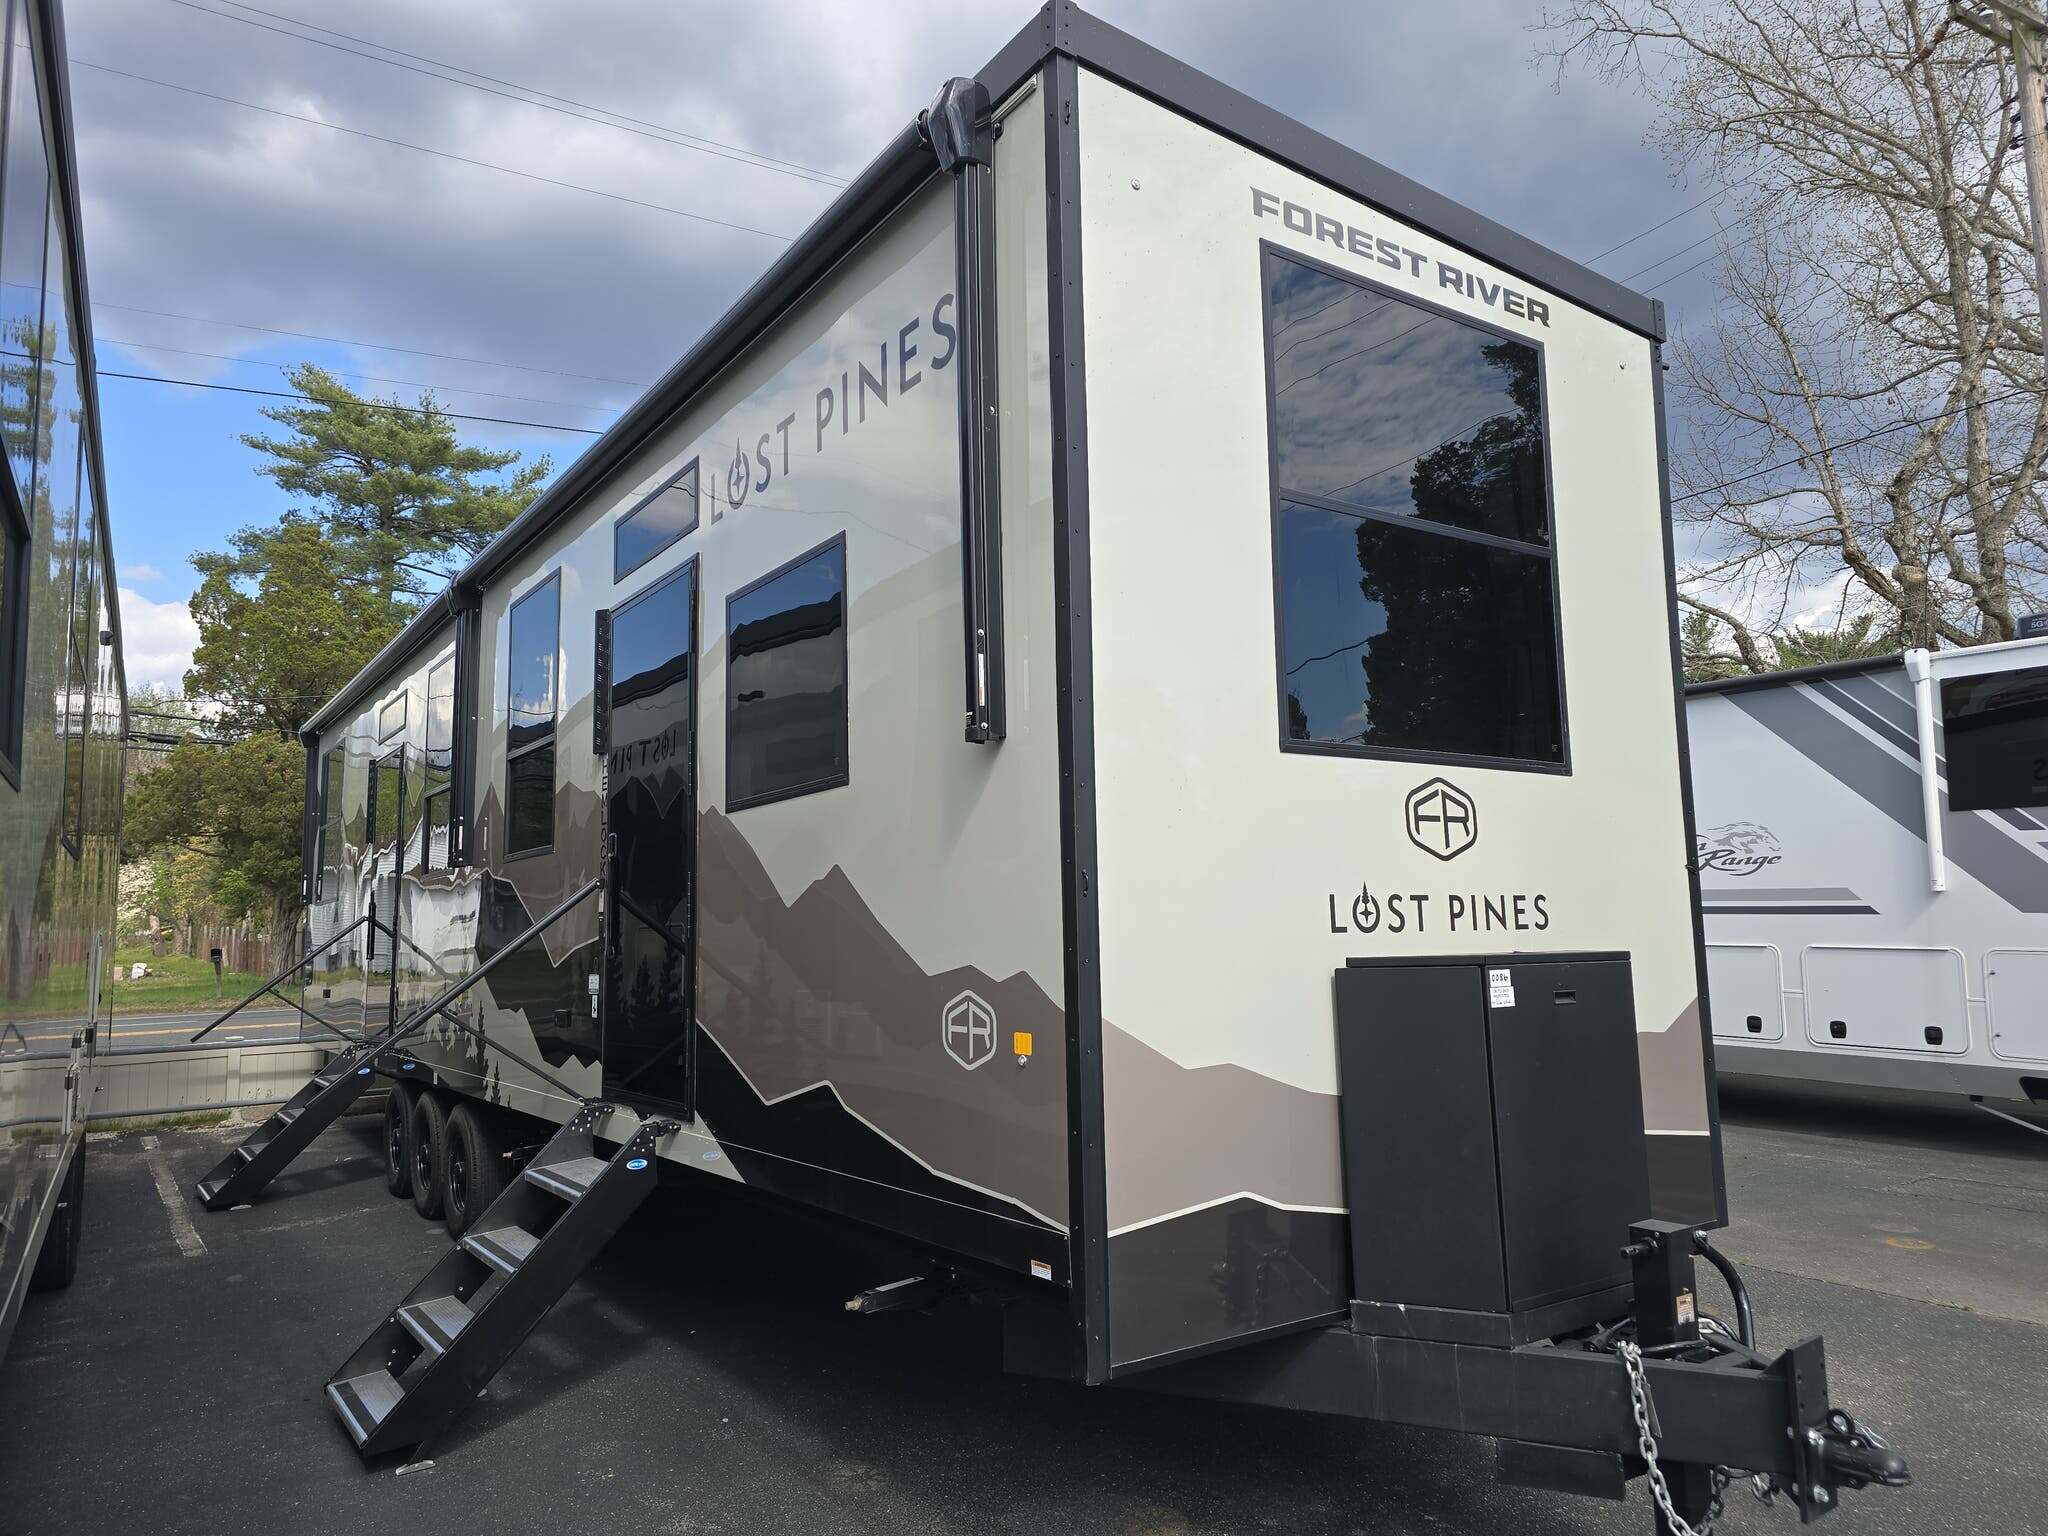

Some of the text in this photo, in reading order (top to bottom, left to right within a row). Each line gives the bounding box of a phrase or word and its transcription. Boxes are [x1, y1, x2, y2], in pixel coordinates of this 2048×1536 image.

[1250, 186, 1551, 328] FOREST RIVER
[711, 293, 957, 526] LOST PINES
[1329, 881, 1550, 934] LOST PINES
[1698, 849, 1783, 877] Range
